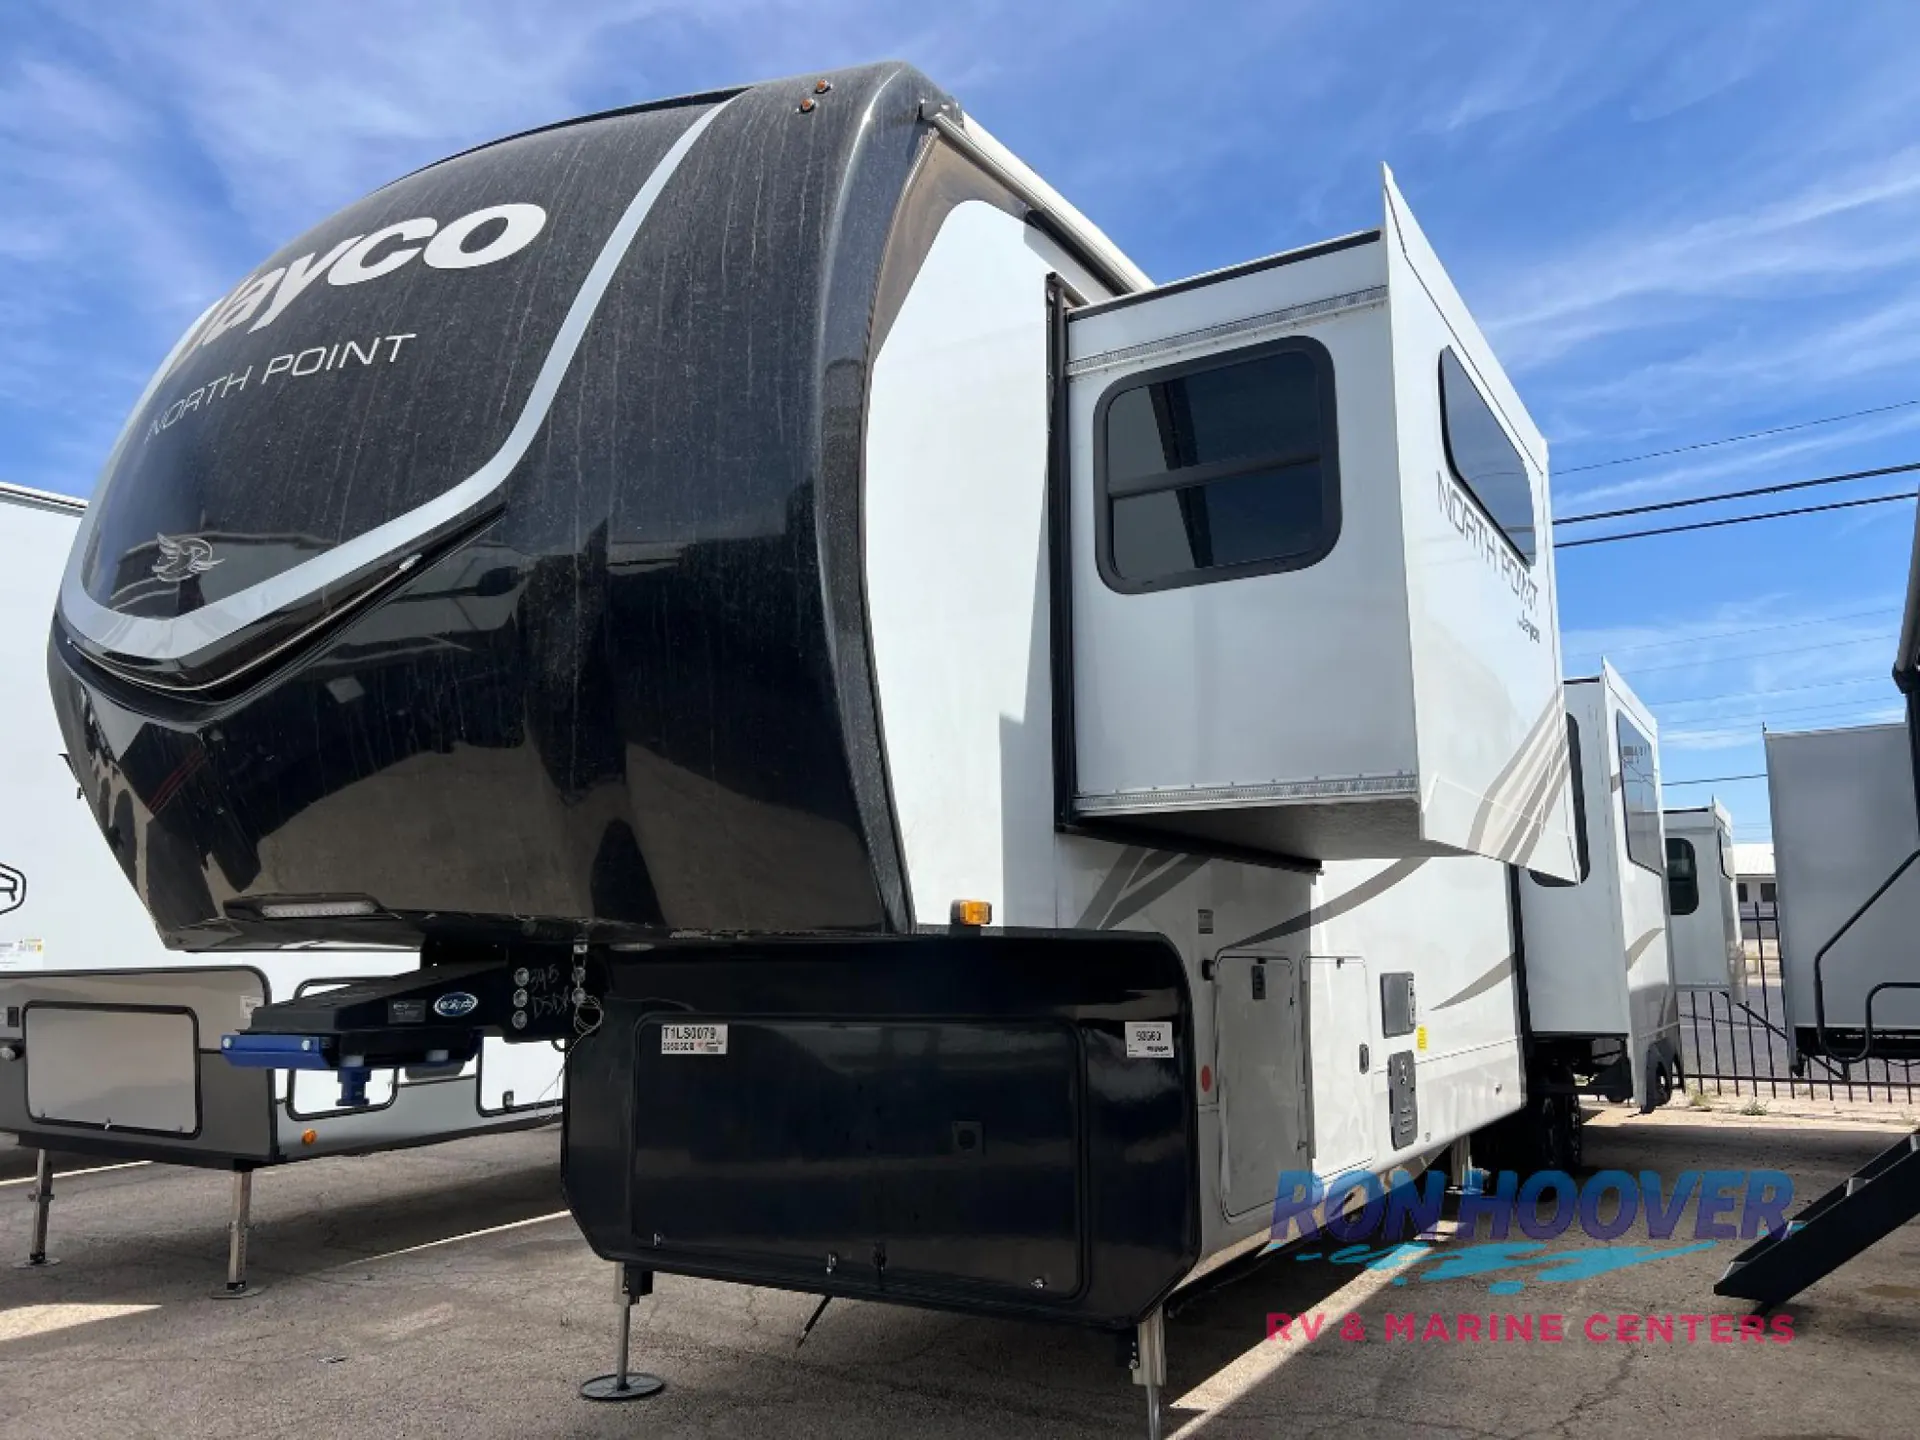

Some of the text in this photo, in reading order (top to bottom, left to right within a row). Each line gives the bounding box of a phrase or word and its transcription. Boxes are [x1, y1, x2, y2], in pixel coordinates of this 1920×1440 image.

[143, 333, 417, 446] NORTH POINT
[1436, 470, 1498, 573] NORTH
